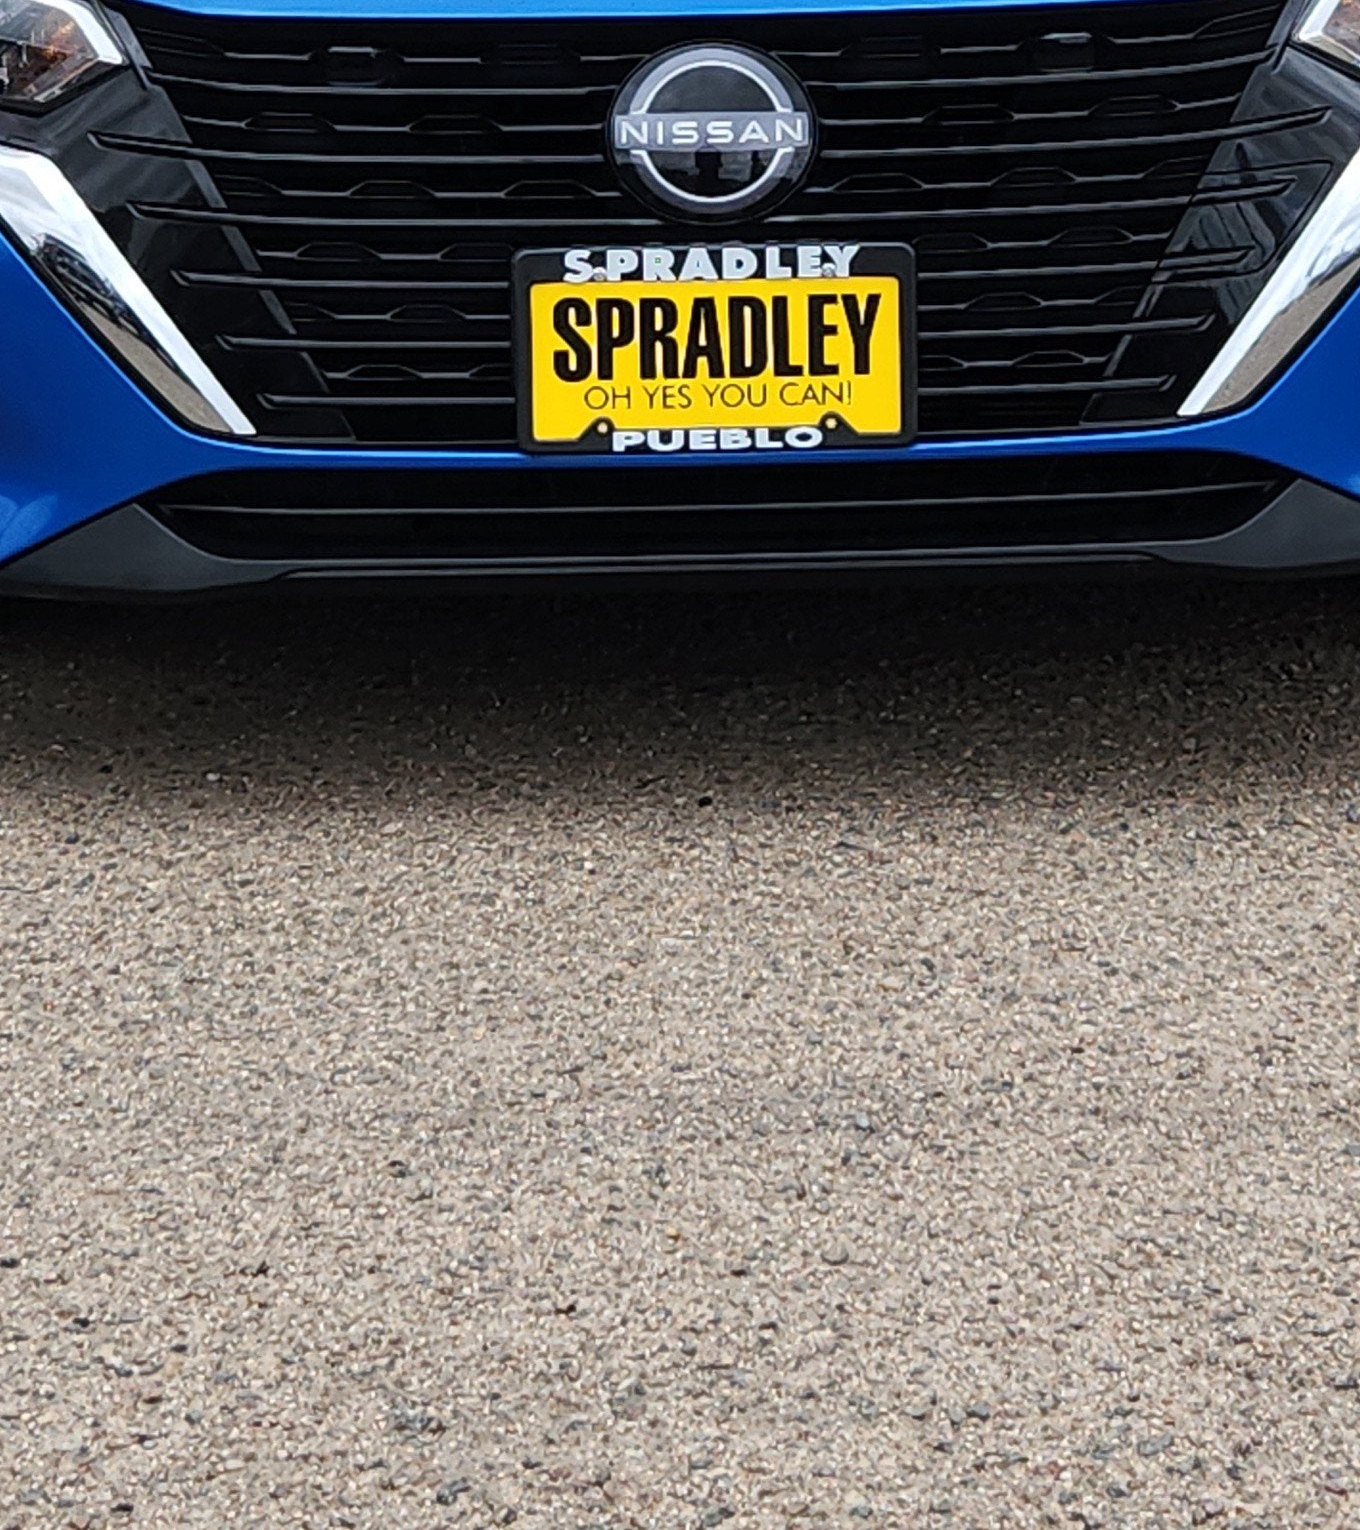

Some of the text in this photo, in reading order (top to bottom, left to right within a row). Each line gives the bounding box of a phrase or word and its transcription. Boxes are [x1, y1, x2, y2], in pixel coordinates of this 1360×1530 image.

[620, 118, 805, 146] NISSAN
[563, 244, 860, 282] SPRADLEY
[552, 292, 882, 382] SPRADLEY
[583, 380, 853, 410] OH YES YOU CAN!
[611, 426, 824, 452] PUEBLO
